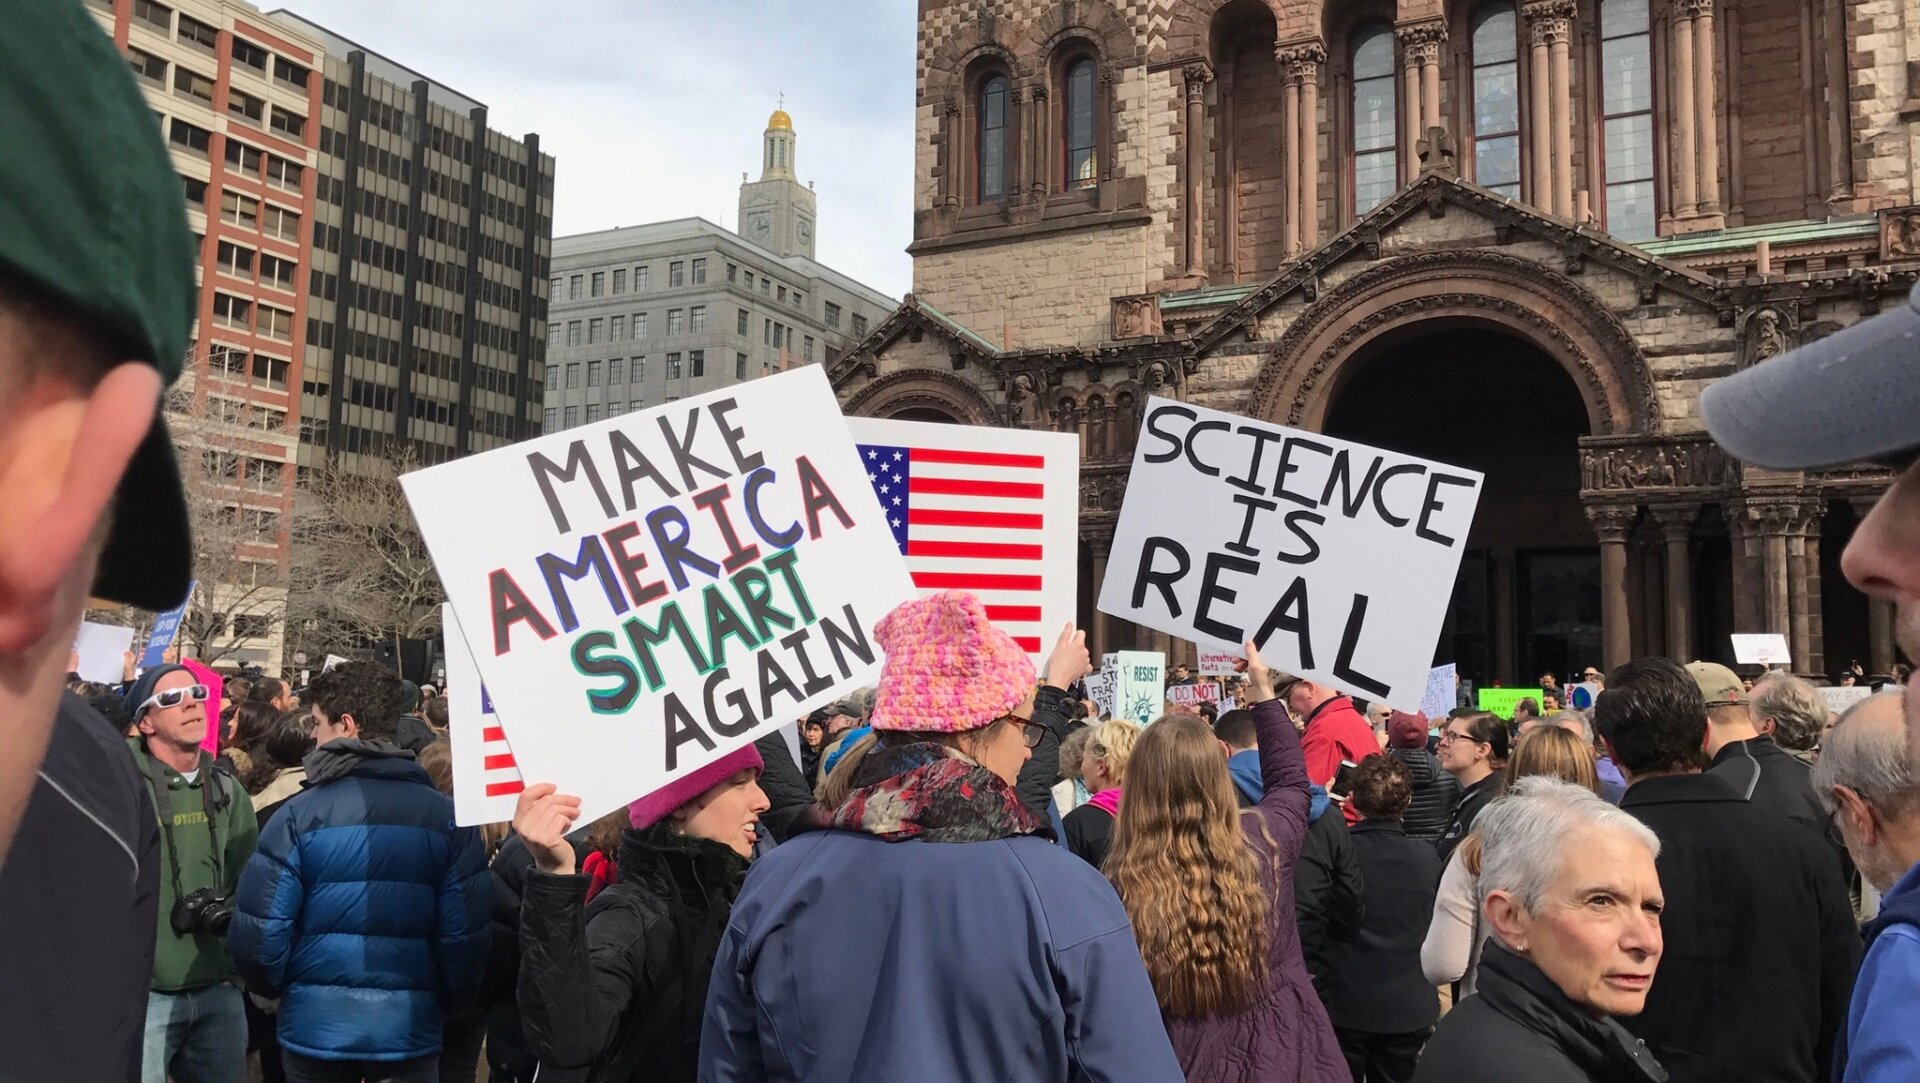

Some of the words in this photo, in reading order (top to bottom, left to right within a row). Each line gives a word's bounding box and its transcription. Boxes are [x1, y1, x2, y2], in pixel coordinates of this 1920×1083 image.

[527, 397, 764, 535] MAKE
[1143, 405, 1476, 548] SCIENCE
[1224, 493, 1326, 565] IS
[487, 455, 856, 657] AMERICA
[1130, 536, 1391, 699] REAL
[569, 546, 818, 715] SMART
[664, 603, 876, 773] AGAIN
[1134, 665, 1159, 682] RESIST
[1175, 686, 1190, 701] DO
[1192, 684, 1216, 700] NOT
